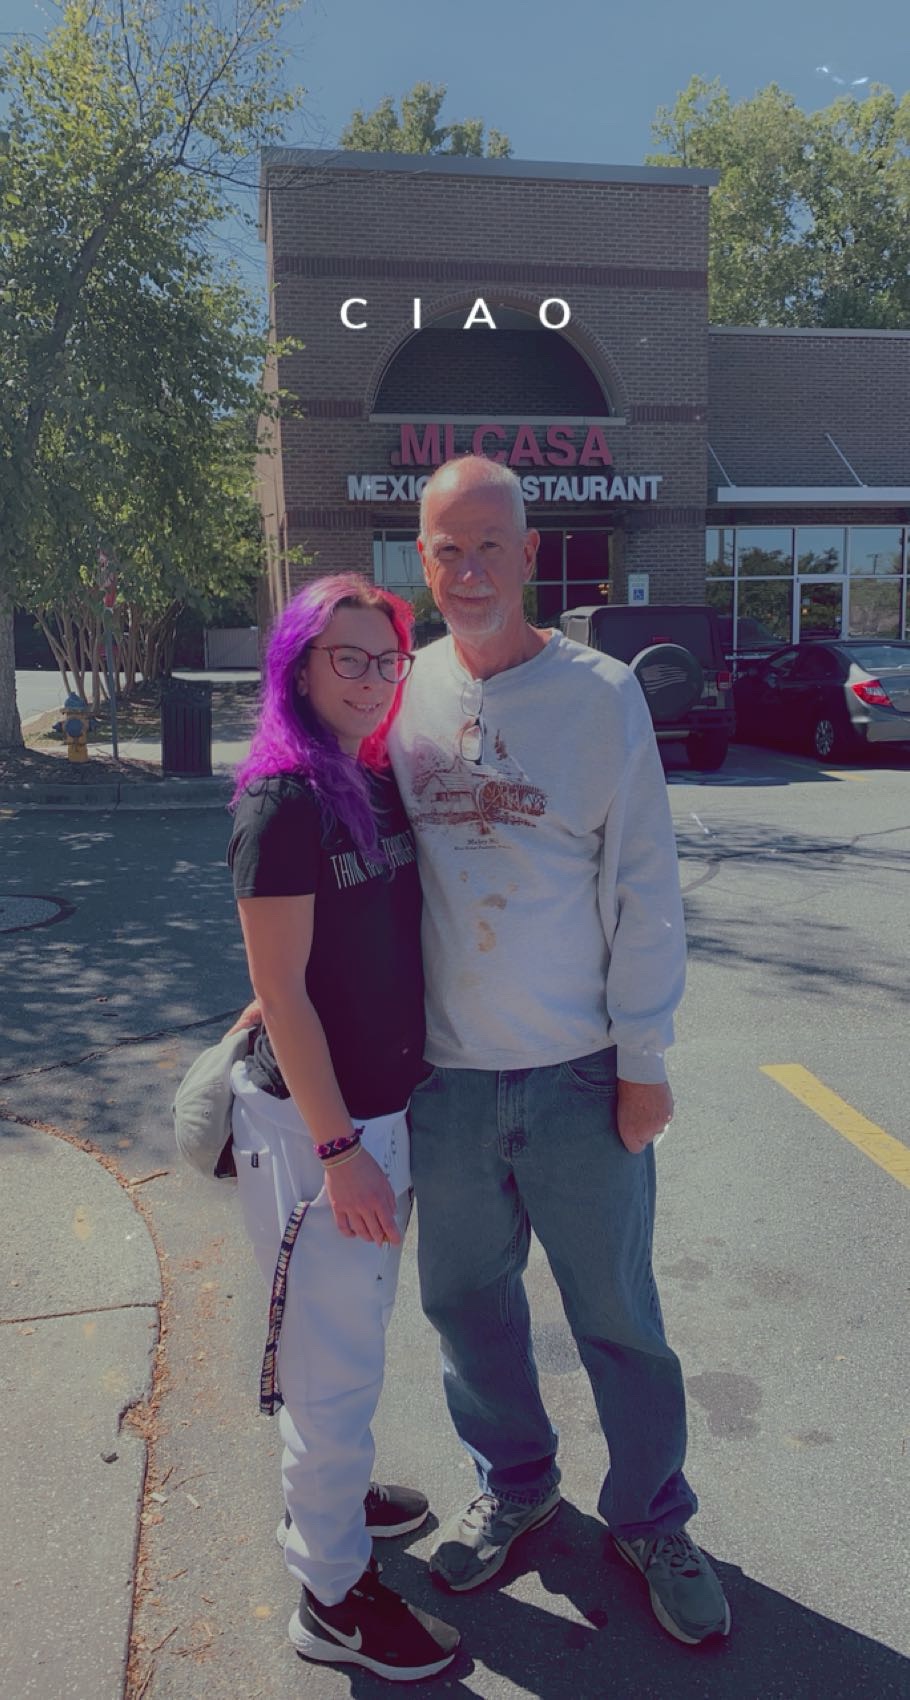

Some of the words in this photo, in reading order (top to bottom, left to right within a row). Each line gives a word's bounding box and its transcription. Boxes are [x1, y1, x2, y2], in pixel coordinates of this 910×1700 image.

[401, 423, 454, 464] MI
[472, 423, 613, 466] CASA
[521, 475, 663, 501] STAURANT
[330, 851, 367, 890] THINK
